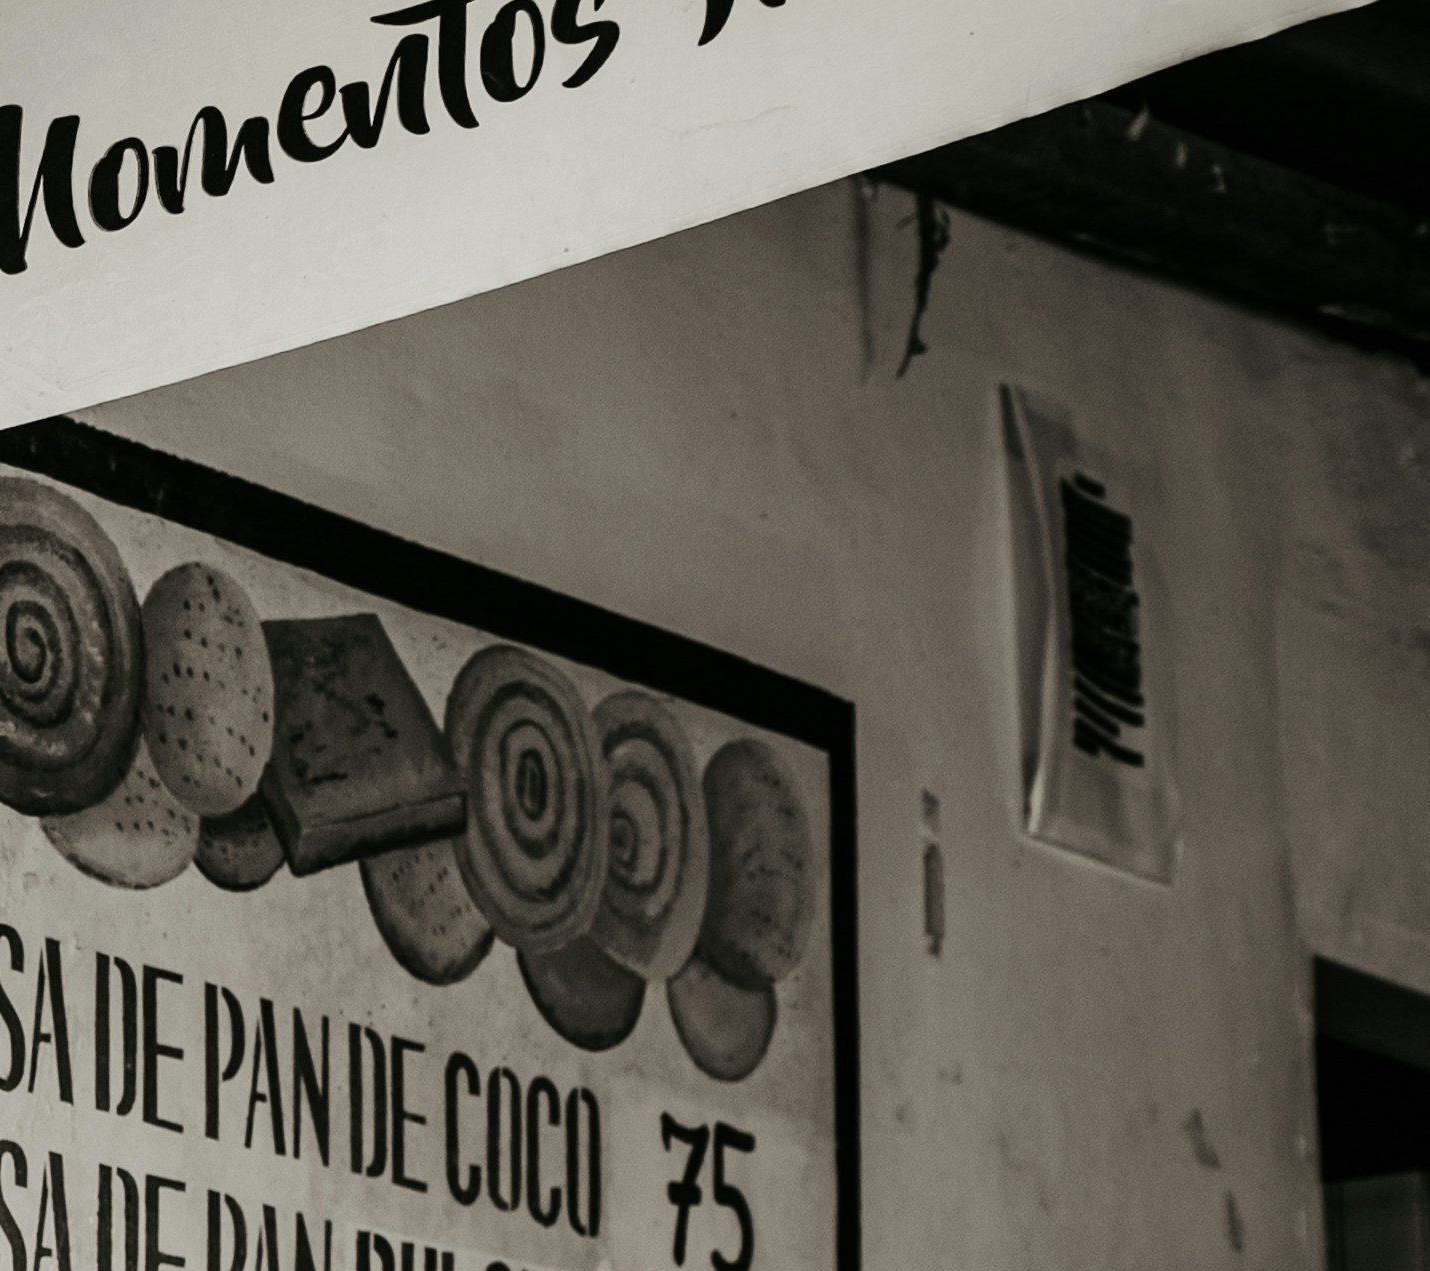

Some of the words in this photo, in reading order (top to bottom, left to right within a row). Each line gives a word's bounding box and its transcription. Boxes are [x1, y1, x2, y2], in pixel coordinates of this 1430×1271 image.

[95, 951, 185, 1135] DE
[204, 981, 331, 1168] PAN
[348, 1021, 429, 1194] DE
[444, 1050, 603, 1238] COCO
